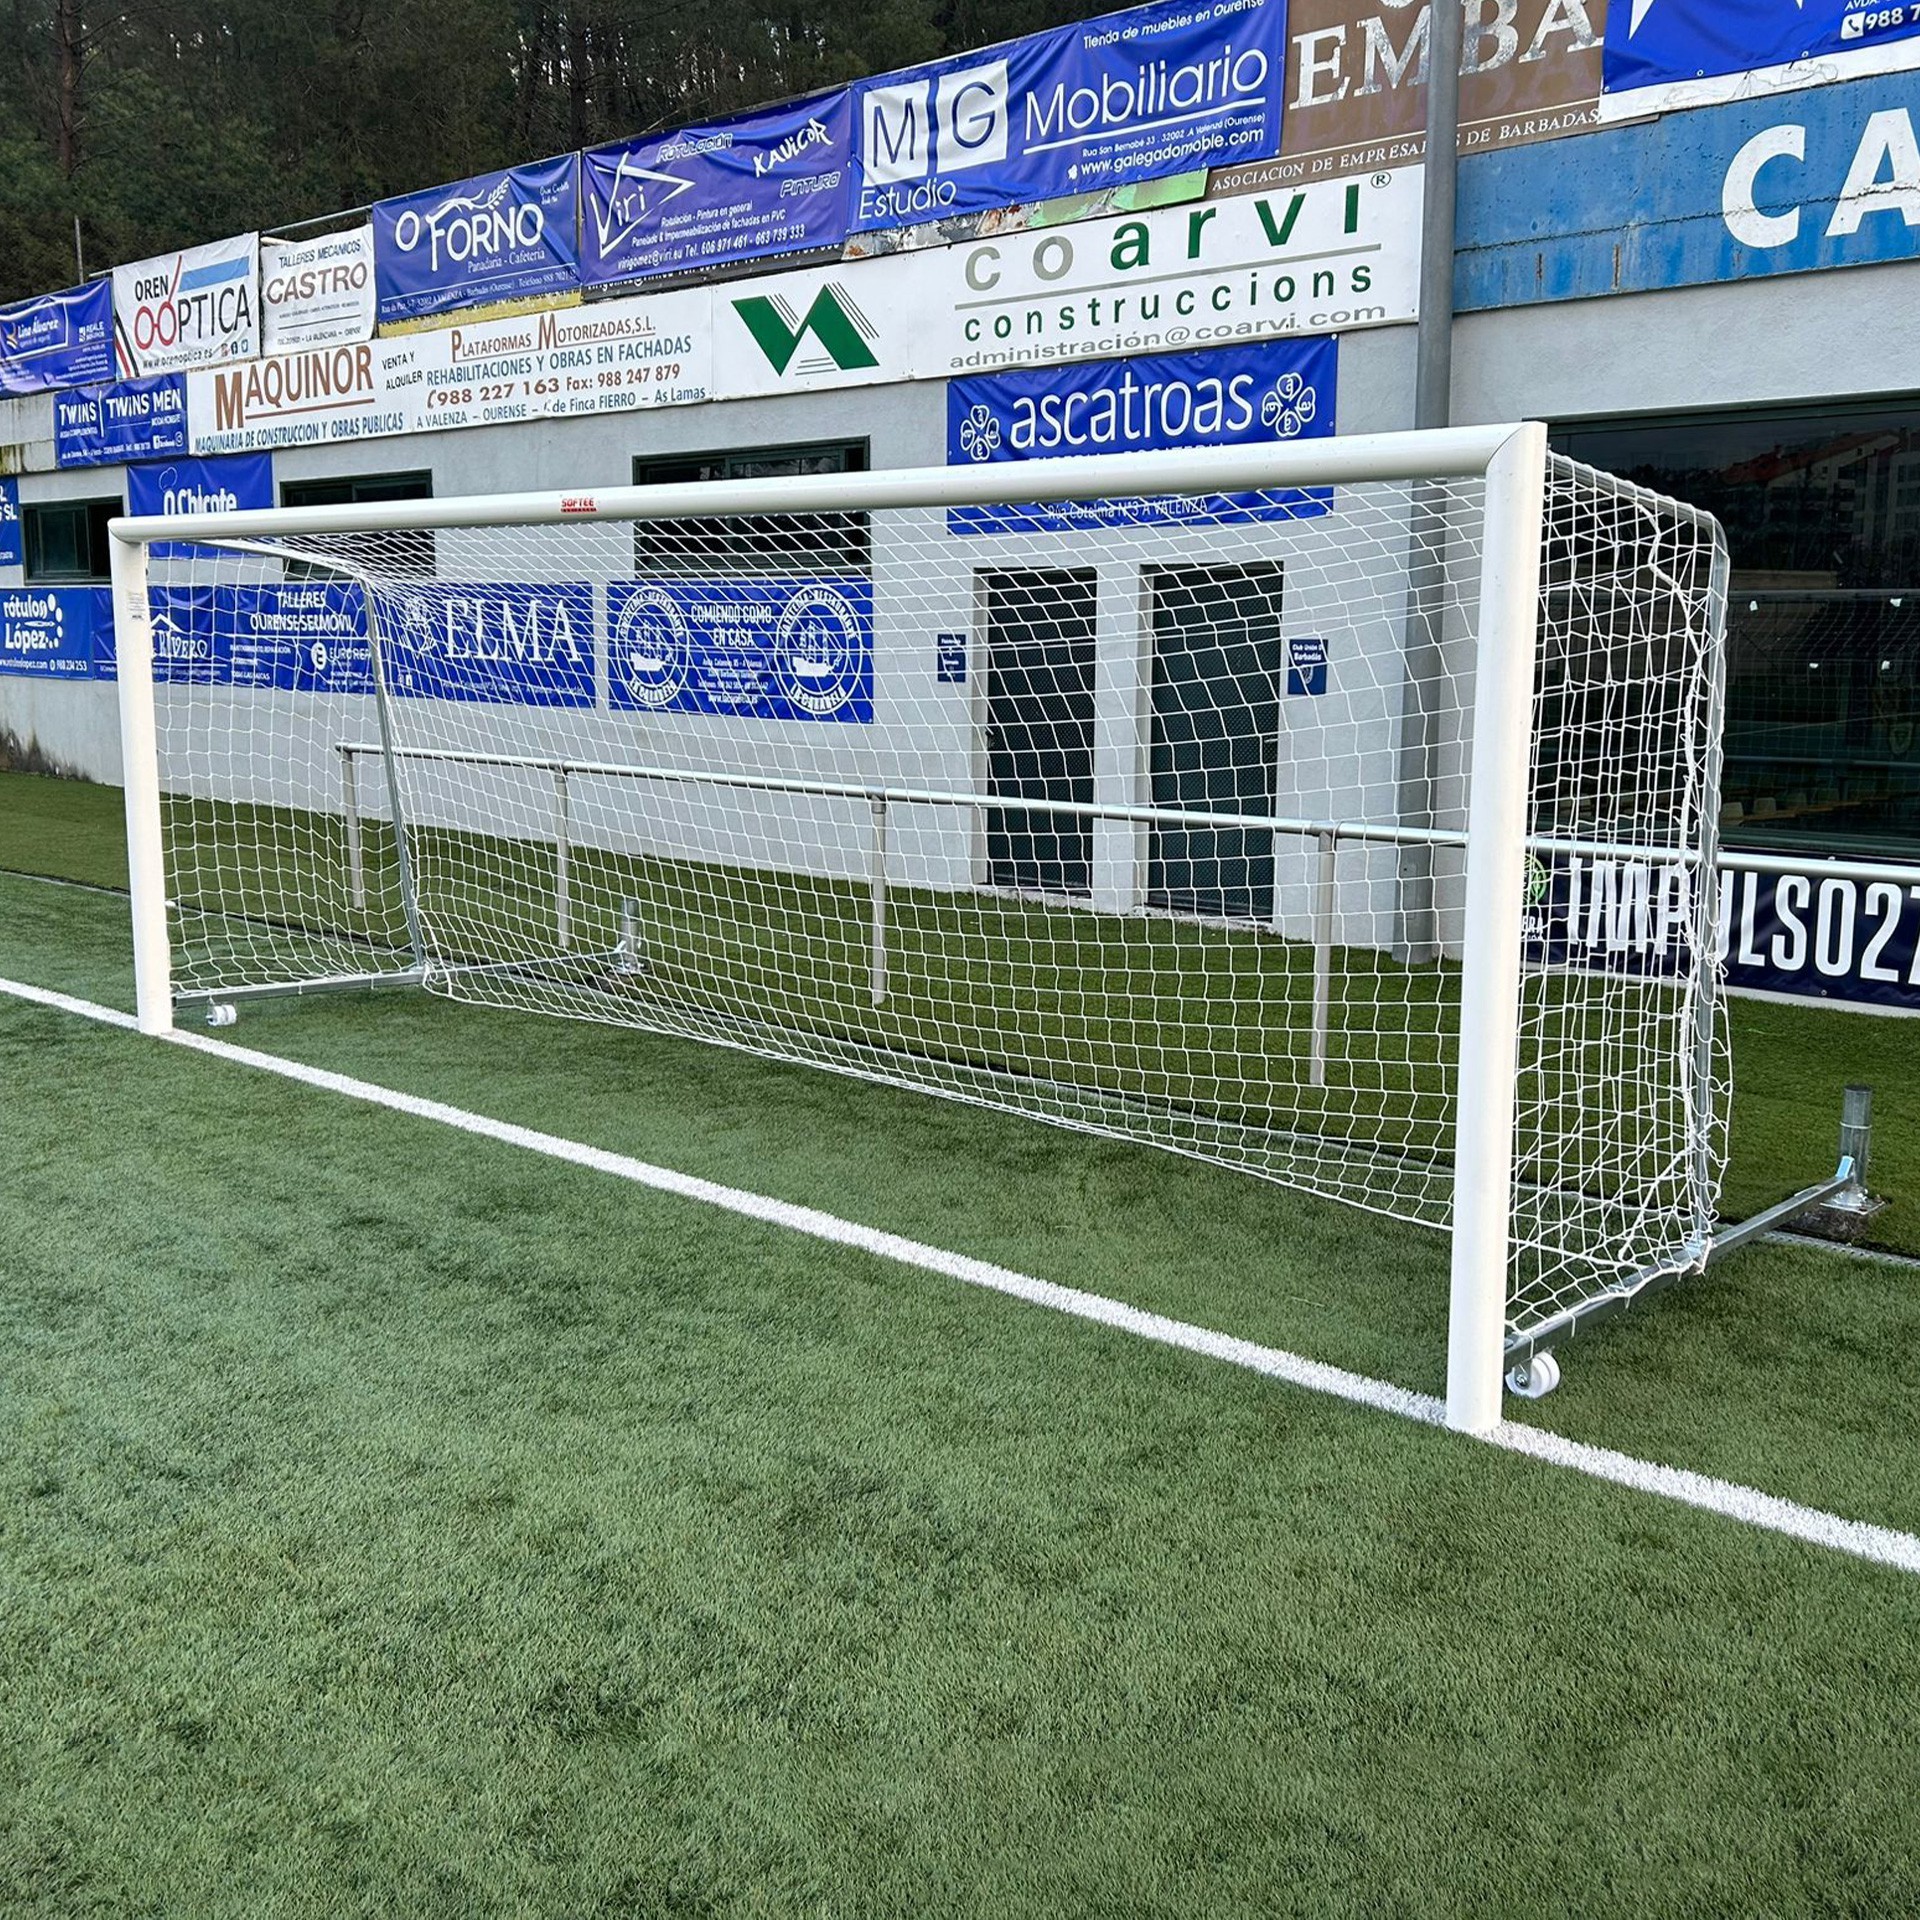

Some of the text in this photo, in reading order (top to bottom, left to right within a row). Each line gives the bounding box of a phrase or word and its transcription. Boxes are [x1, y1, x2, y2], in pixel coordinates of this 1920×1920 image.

[1083, 0, 1264, 49] Tienda de muebles en Ourense
[1866, 7, 1904, 30] 988
[1026, 45, 1269, 141] Mobiliario
[1081, 128, 1264, 176] www.galegadomoble.com
[1098, 144, 1113, 155] San
[1223, 113, 1266, 129] (Ourense)
[1212, 163, 1304, 192] ASOCIACION
[1311, 157, 1334, 175] DE
[1466, 127, 1491, 146] DE
[1498, 109, 1602, 140] BARBADAS
[720, 207, 728, 216] en
[761, 213, 770, 223] en
[771, 209, 786, 222] PVC
[859, 177, 957, 219] Estudio
[278, 239, 361, 268] TALLERES MECANICOS
[395, 199, 544, 272] O FORNO
[685, 245, 699, 258] Tel.
[717, 238, 732, 252] 971
[790, 224, 806, 239] 333
[964, 184, 1360, 292] coarvi
[134, 274, 169, 302] OREN
[266, 262, 368, 305] CASTRO
[964, 264, 1373, 341] construccions
[382, 350, 415, 371] VENTA Y
[427, 334, 692, 387] REHABILITACIONES Y OBRAS EN FACHADAS
[451, 329, 532, 363] PLATAFORMAS
[215, 344, 374, 432] MAQUINOR
[386, 370, 423, 391] ALQUILER
[437, 363, 681, 406] 988 227 163 Fax: 988 247 879
[59, 388, 182, 426] TWINS TWINS MEN
[416, 417, 423, 429] A
[426, 410, 468, 428] VALENZA
[483, 403, 527, 422] OURENSE
[552, 399, 566, 412] de
[570, 397, 595, 411] Finca
[599, 392, 636, 409] FIERRO
[655, 389, 668, 403] As
[670, 386, 706, 402] Lamas
[1010, 371, 1254, 451] ascatroas
[194, 412, 404, 453] MAQUINARIA DE CONSTRUCCION Y OBRAS PUBLICAS
[3, 594, 48, 619] rótulos
[278, 591, 326, 608] TALLERES
[691, 604, 772, 624] COMIENDO COMO
[5, 622, 47, 655] López
[443, 599, 583, 662] ELMA
[714, 628, 755, 646] EN CASA
